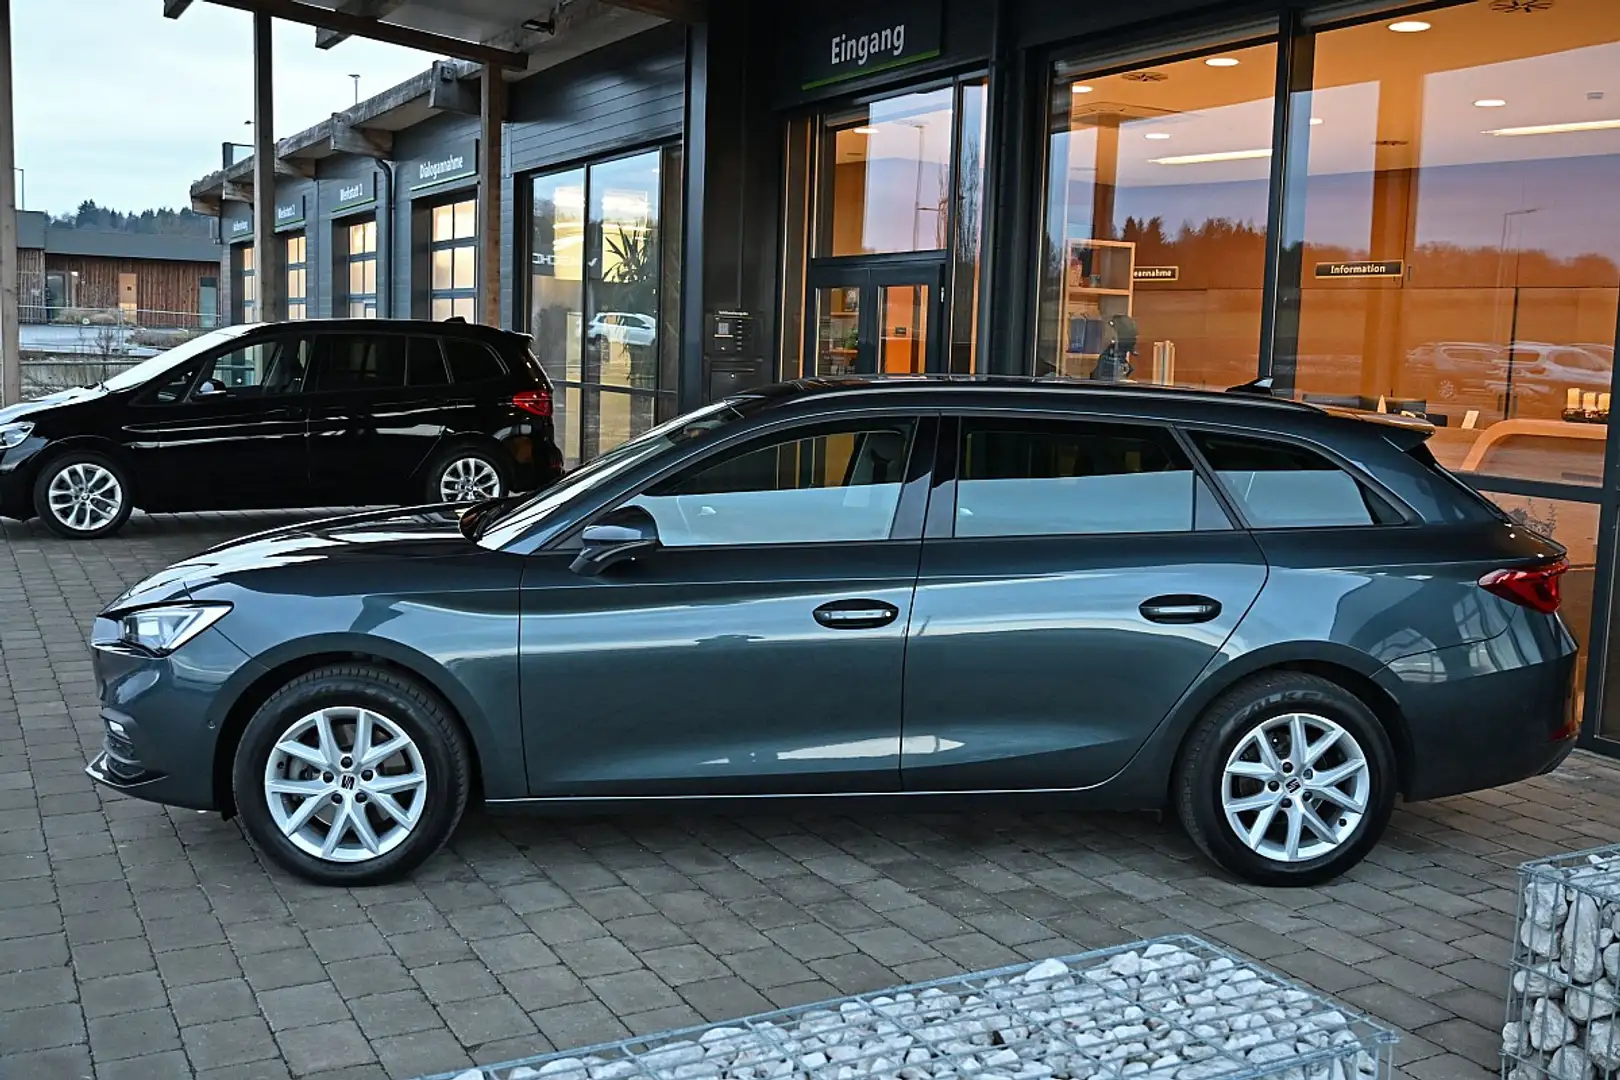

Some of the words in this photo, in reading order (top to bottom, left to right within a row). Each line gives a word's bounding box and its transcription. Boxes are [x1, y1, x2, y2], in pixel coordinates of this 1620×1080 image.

[831, 24, 905, 65] Eingang
[420, 154, 463, 180] Dialogannahme
[1330, 264, 1386, 274] Information
